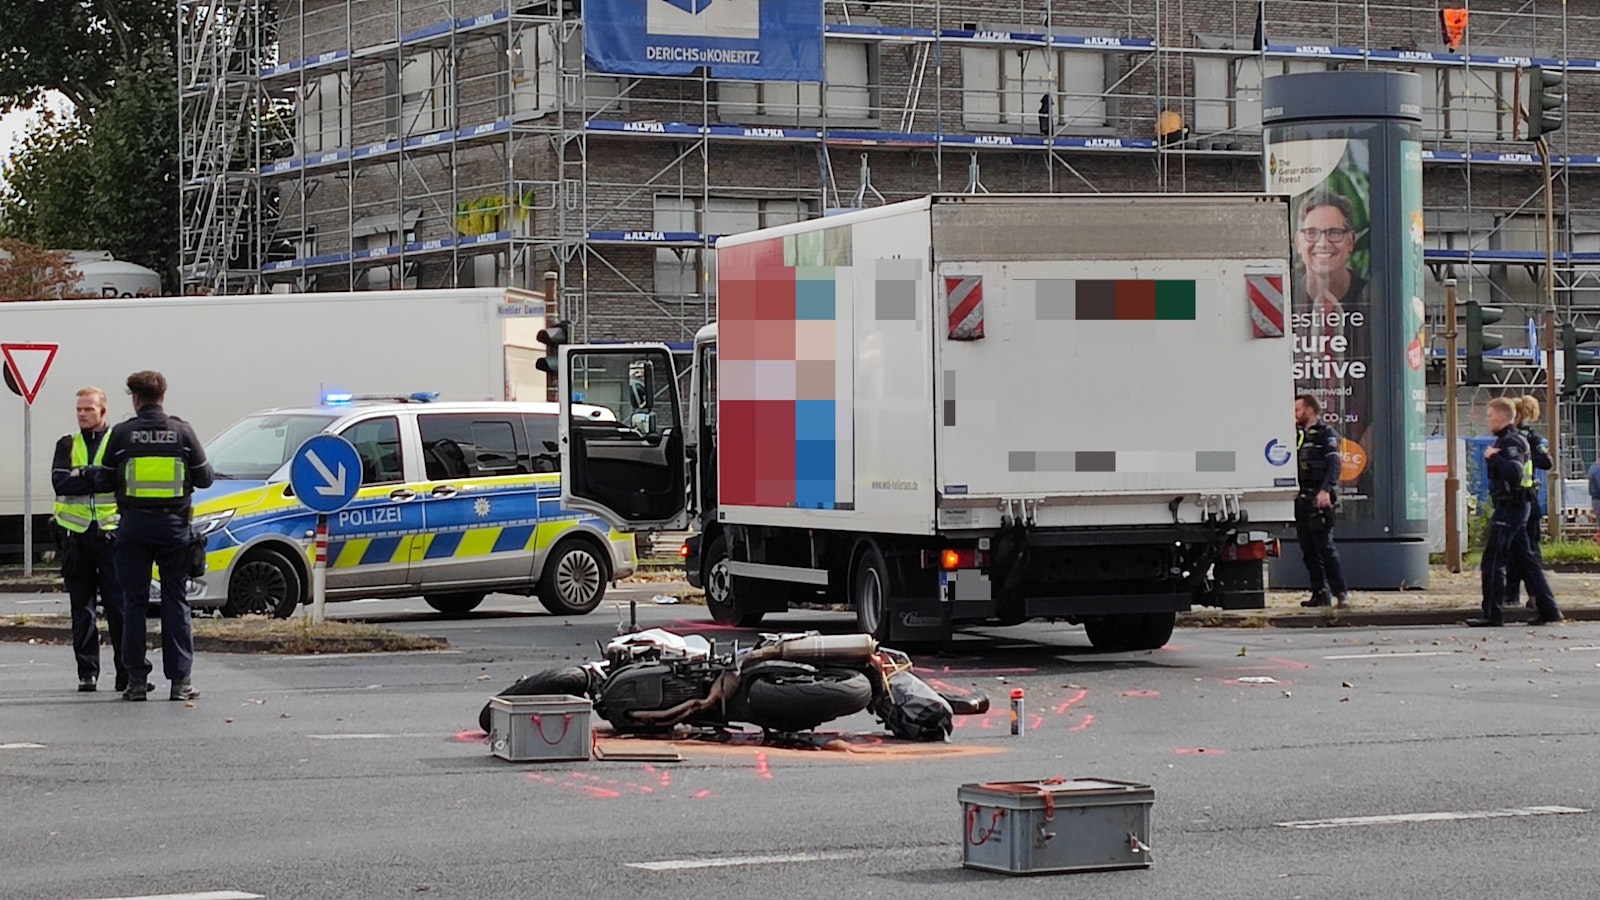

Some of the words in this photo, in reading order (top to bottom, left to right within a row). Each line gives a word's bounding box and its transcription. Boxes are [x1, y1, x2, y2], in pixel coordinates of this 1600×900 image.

[978, 31, 1011, 40] ALPHA
[1091, 38, 1121, 46] ALPHA
[631, 122, 665, 133] ALPHA
[751, 129, 785, 138] ALPHA
[981, 136, 1013, 145] ALPHA
[1091, 139, 1123, 147] ALPHA
[1278, 159, 1290, 167] The
[1505, 154, 1533, 163] ALPHA
[1278, 166, 1322, 175] Generation
[1278, 176, 1301, 184] Forest
[630, 231, 665, 241] ALPHA
[1292, 332, 1348, 353] ture
[1292, 355, 1367, 379] sitive
[1345, 413, 1359, 422] zu
[130, 430, 178, 443] POLIZEI
[339, 506, 401, 527] POLIZEI
